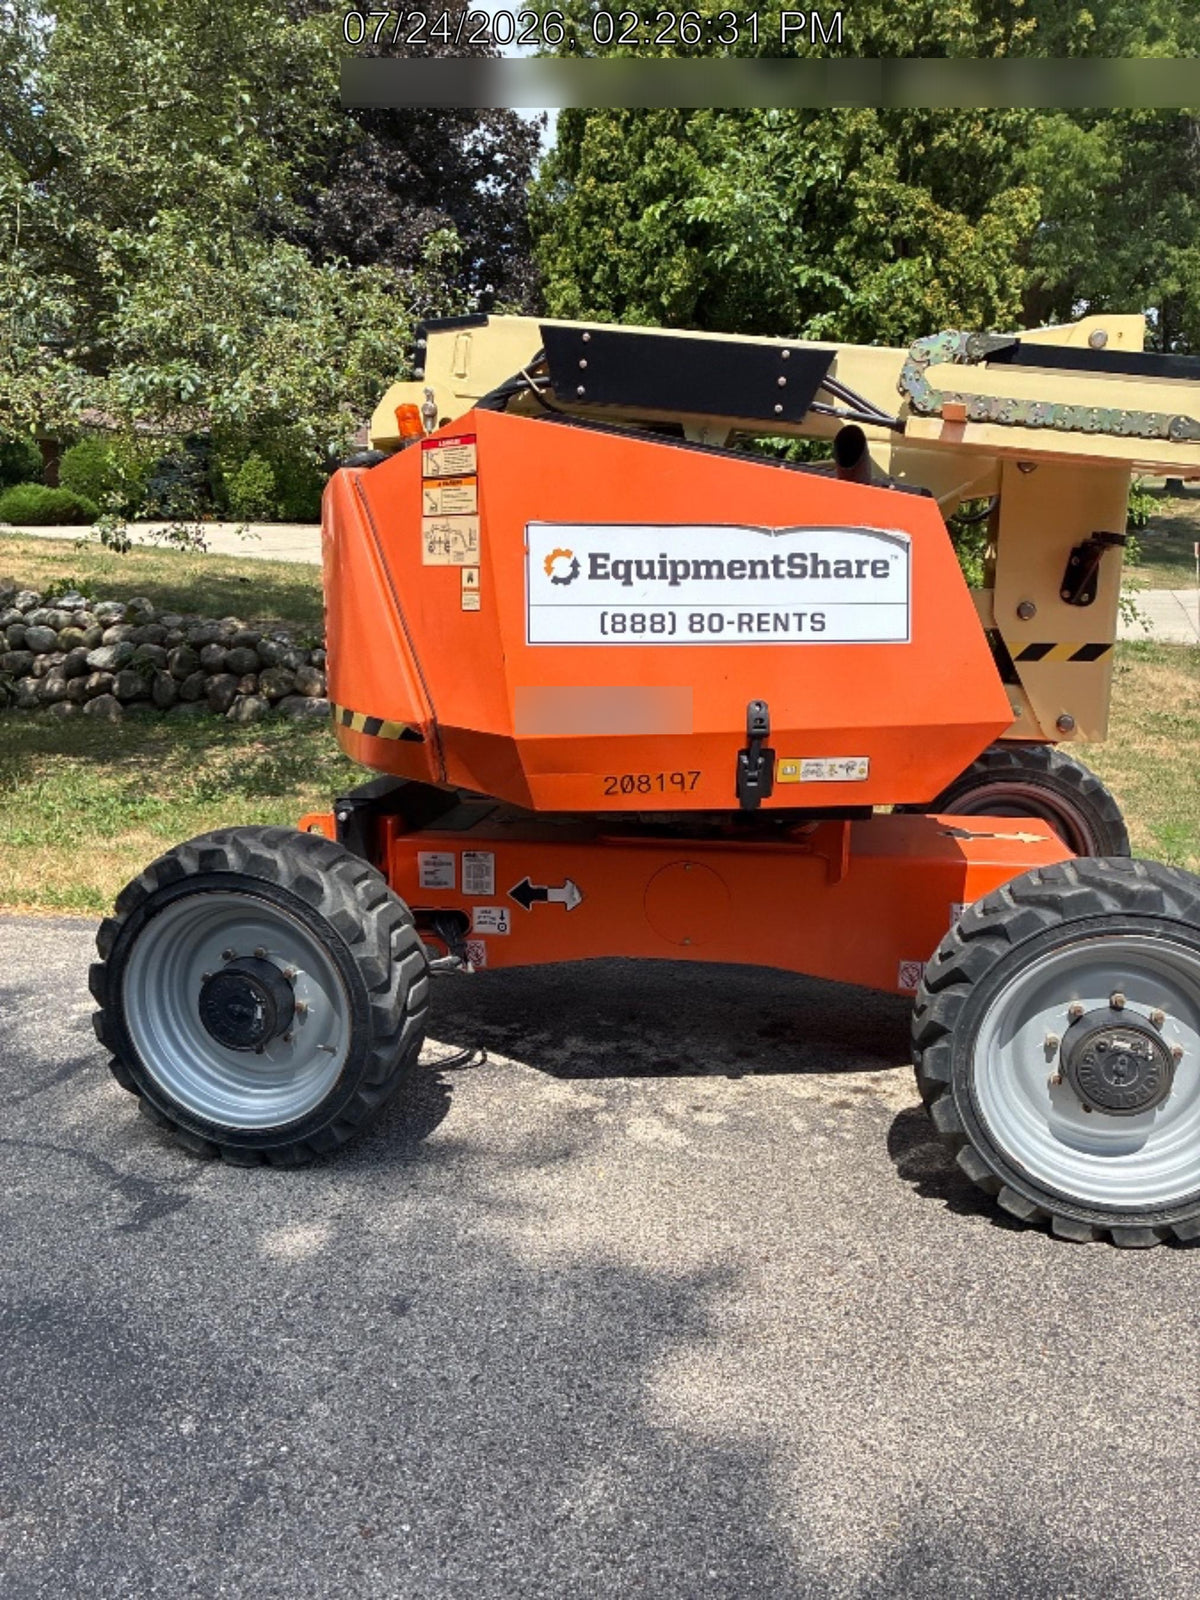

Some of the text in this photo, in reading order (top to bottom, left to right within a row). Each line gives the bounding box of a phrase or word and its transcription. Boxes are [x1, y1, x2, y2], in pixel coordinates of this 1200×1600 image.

[600, 611, 827, 635] (888) 80-RENTS
[603, 770, 702, 796] 208197
